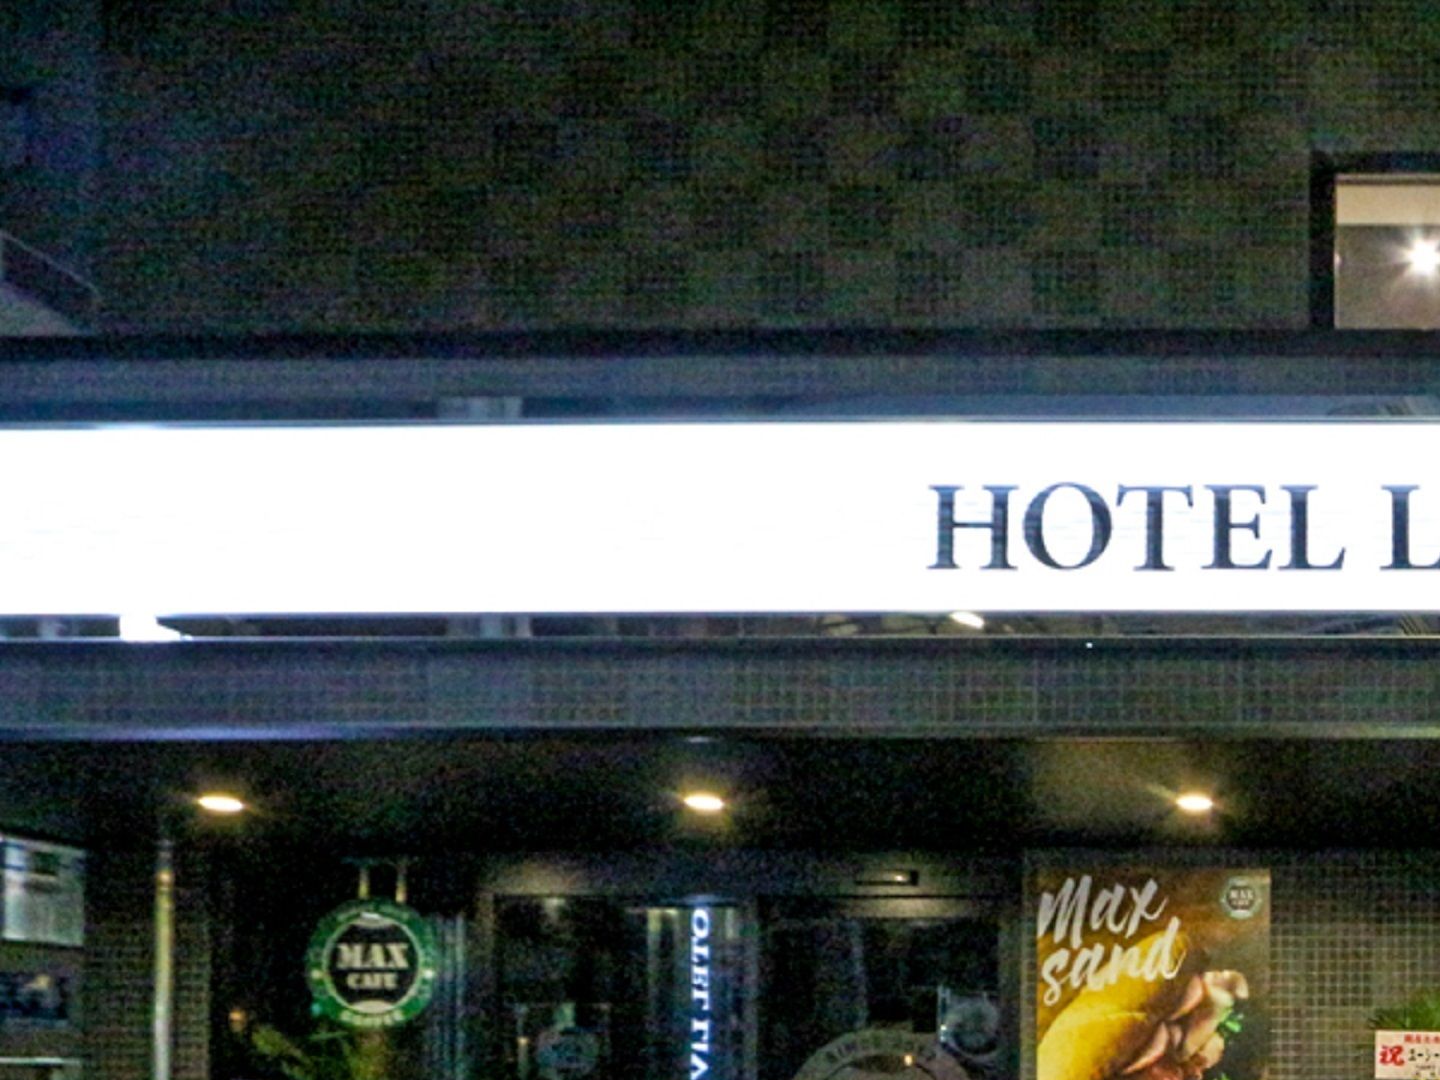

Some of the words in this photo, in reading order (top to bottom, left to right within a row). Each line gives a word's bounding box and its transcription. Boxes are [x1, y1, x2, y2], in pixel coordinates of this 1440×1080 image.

[927, 483, 1346, 571] HOTEL
[1036, 875, 1168, 948] Max
[336, 942, 410, 969] MAX
[1041, 916, 1187, 1007] sand
